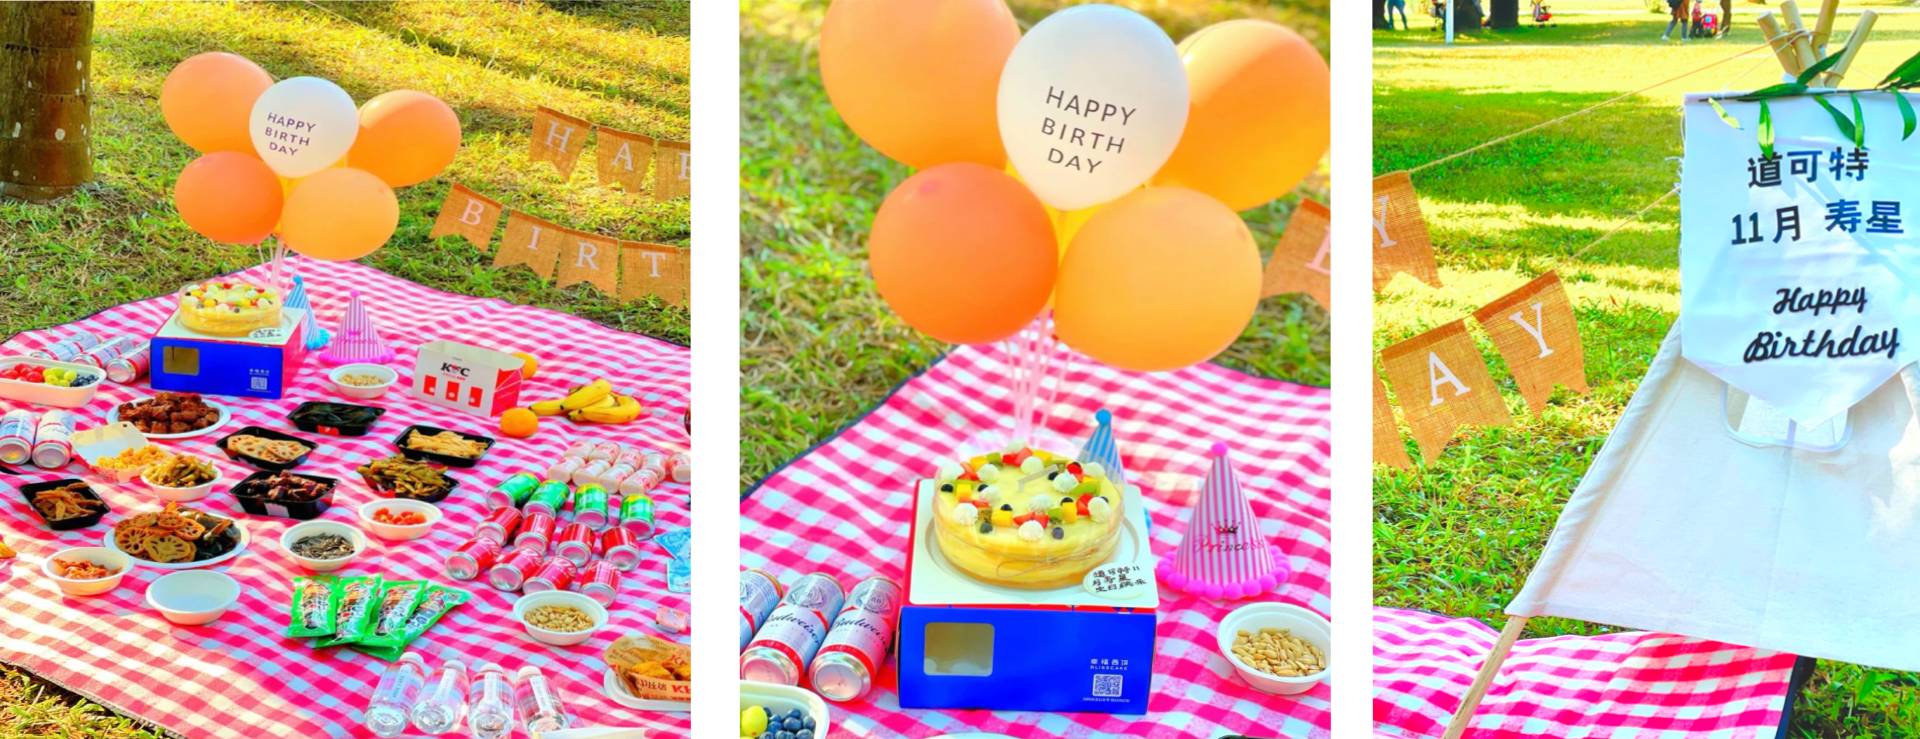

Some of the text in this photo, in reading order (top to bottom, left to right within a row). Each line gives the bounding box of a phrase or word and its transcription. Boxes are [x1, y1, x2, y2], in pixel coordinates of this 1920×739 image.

[266, 111, 317, 133] HAPPY
[1045, 85, 1137, 126] HAPPY
[264, 126, 310, 147] BIRTH
[268, 141, 298, 156] DAY
[1041, 117, 1125, 154] BIRTH
[1047, 147, 1103, 174] DAY
[1747, 146, 1870, 188] 道可特
[1731, 199, 1905, 246] 11月 寿星
[1772, 286, 1868, 316] Happy
[1743, 325, 1900, 363] Birthday
